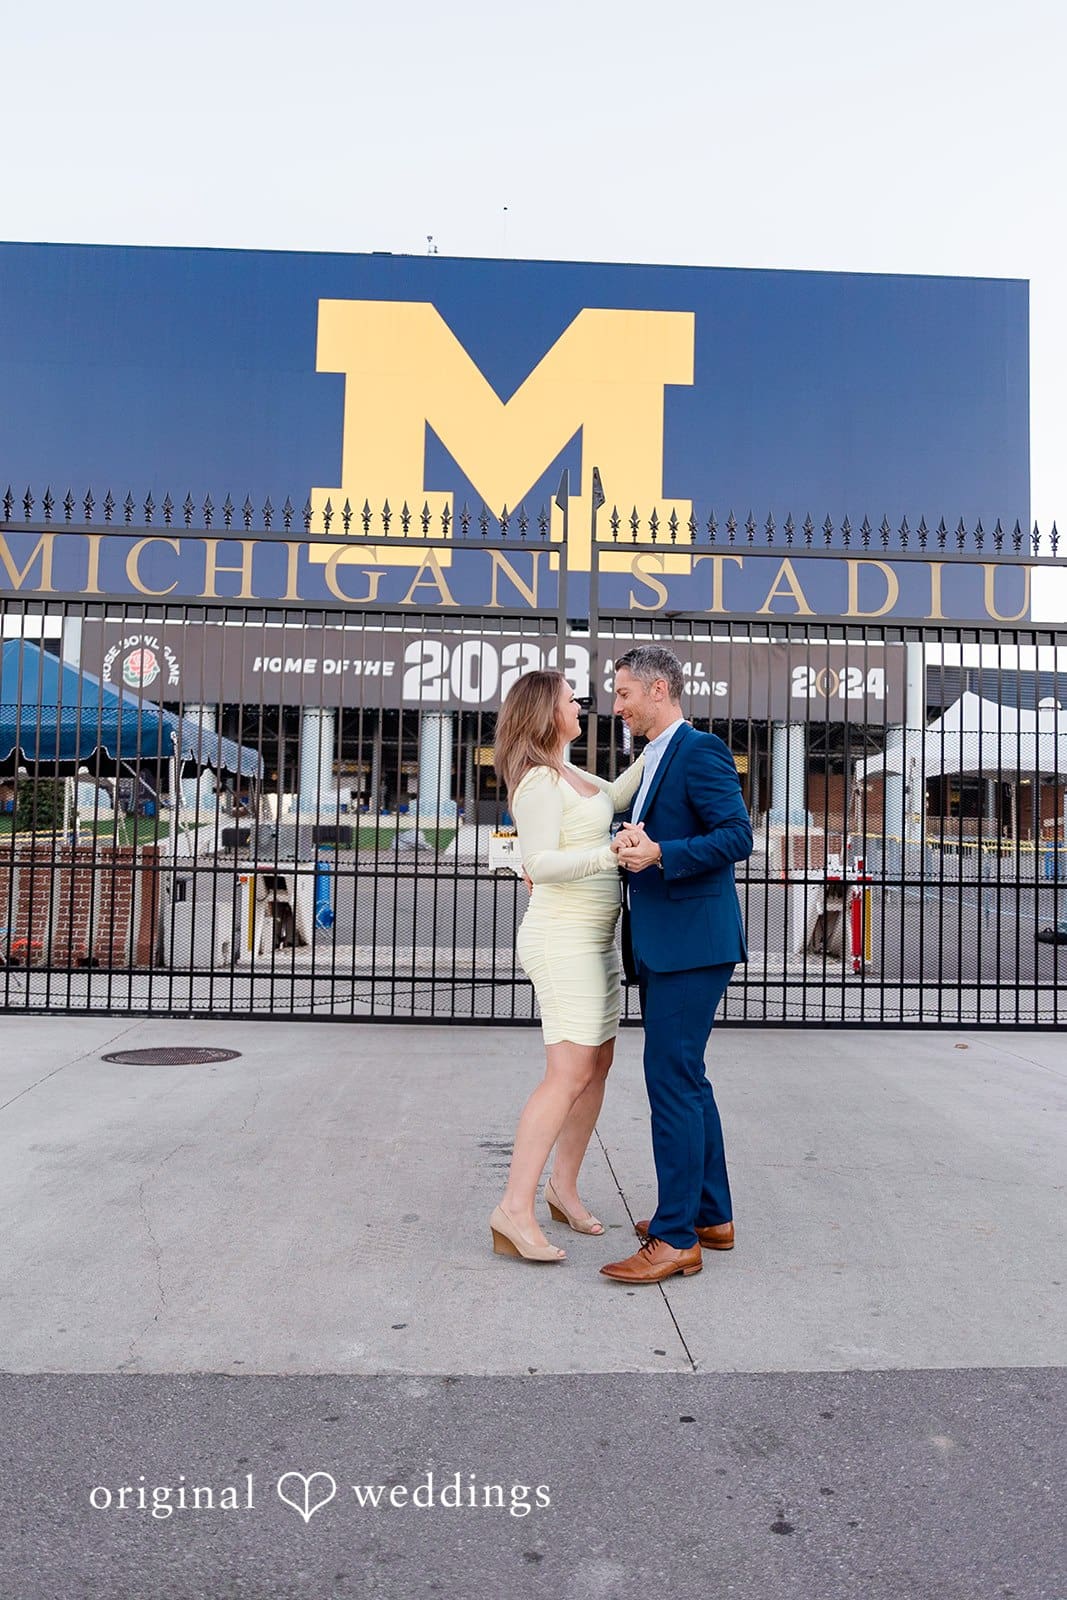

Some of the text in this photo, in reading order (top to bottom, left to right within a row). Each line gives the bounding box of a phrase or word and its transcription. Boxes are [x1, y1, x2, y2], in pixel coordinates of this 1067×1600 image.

[309, 298, 695, 575] M
[0, 533, 542, 609] MICHIGAN
[103, 634, 180, 686] ROSE BOWL GAME
[253, 657, 317, 674] HOME
[323, 659, 350, 675] OF
[353, 660, 395, 676] THE
[402, 640, 590, 703] 2023
[791, 665, 889, 700] 2024
